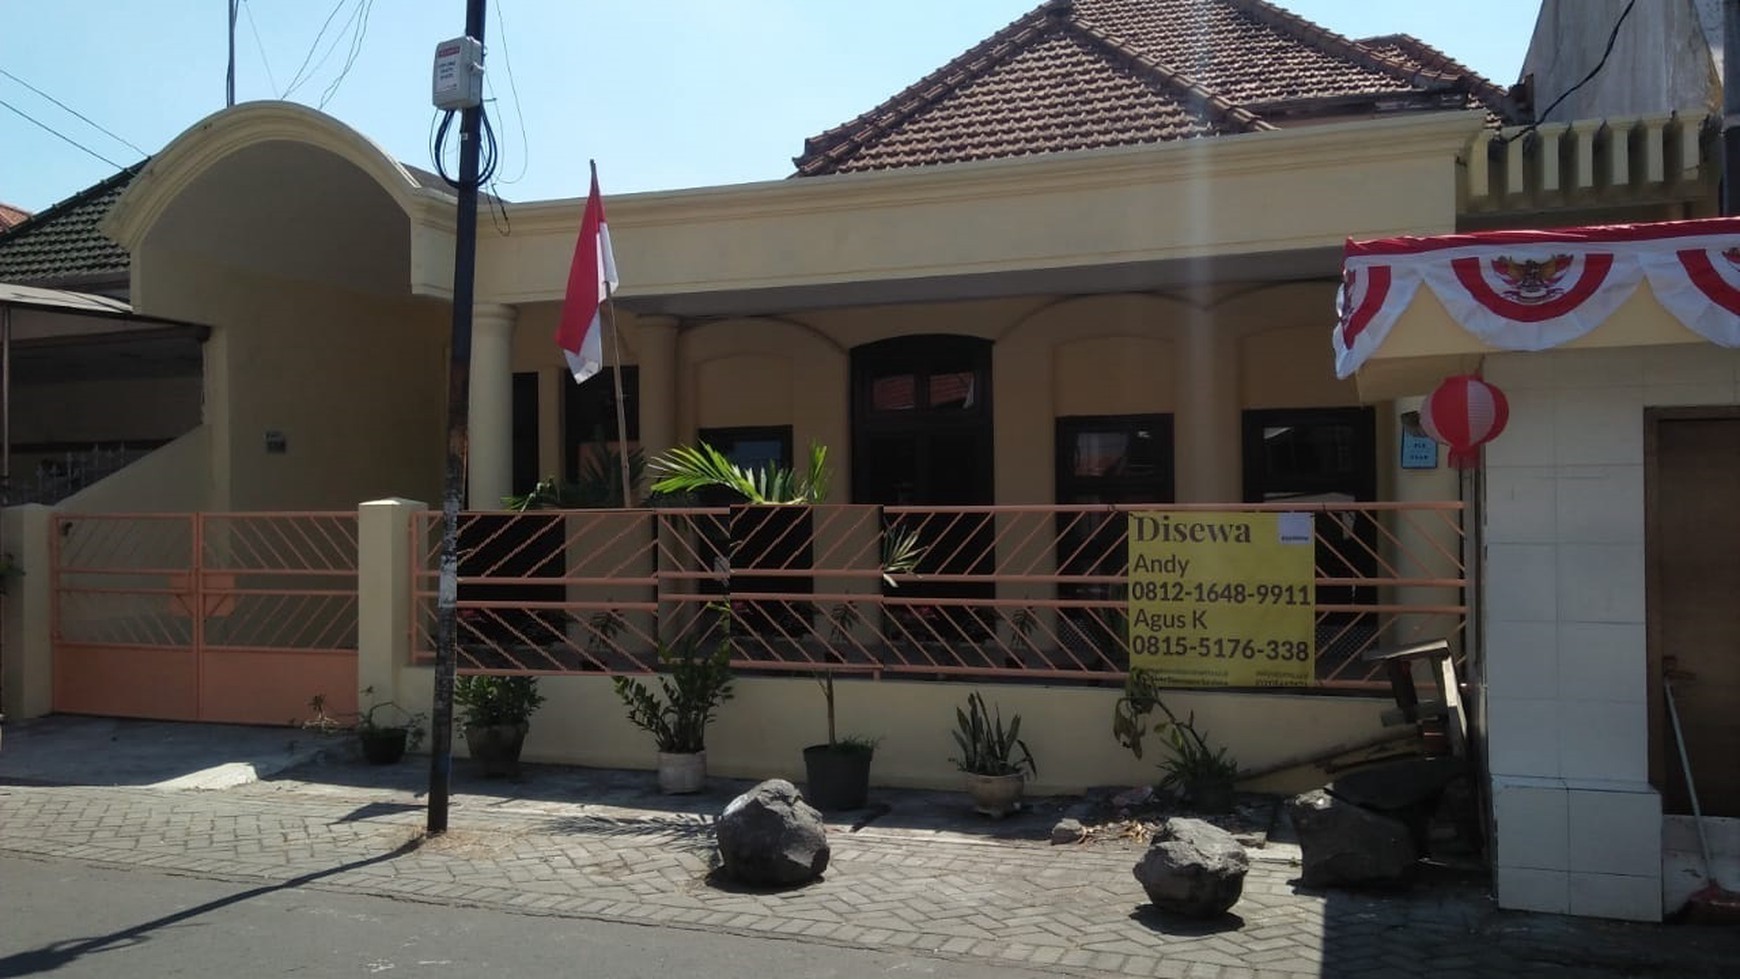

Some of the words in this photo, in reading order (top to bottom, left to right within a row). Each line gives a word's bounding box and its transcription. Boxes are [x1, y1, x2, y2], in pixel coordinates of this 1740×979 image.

[1134, 515, 1252, 543] Disewa
[1133, 554, 1190, 577] Andy
[1132, 581, 1311, 605] 0812-1648-9911
[1133, 609, 1186, 632] Agus
[1193, 610, 1208, 630] K
[1132, 635, 1309, 662] 0815-5176-338
